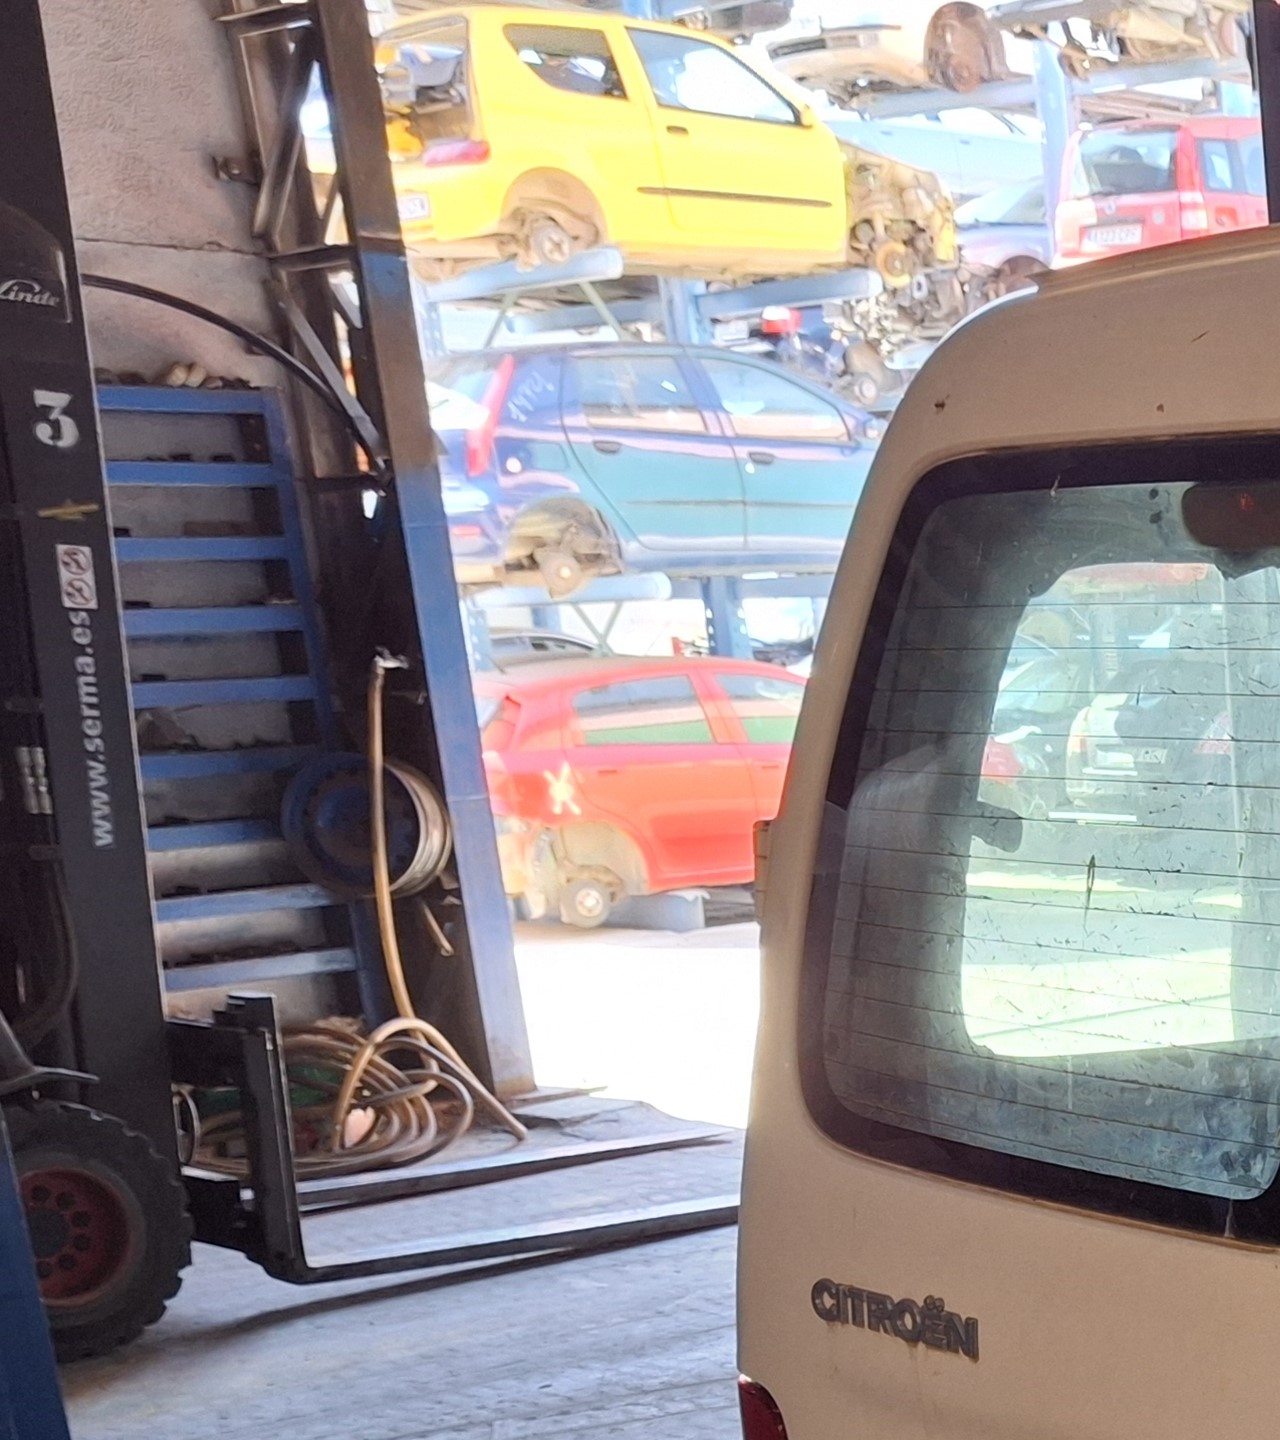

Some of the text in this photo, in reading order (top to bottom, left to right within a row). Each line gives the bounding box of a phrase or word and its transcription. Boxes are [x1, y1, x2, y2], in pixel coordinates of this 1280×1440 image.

[33, 388, 79, 449] 3
[68, 610, 114, 847] www.serma.es
[811, 1278, 979, 1364] CITROËN
